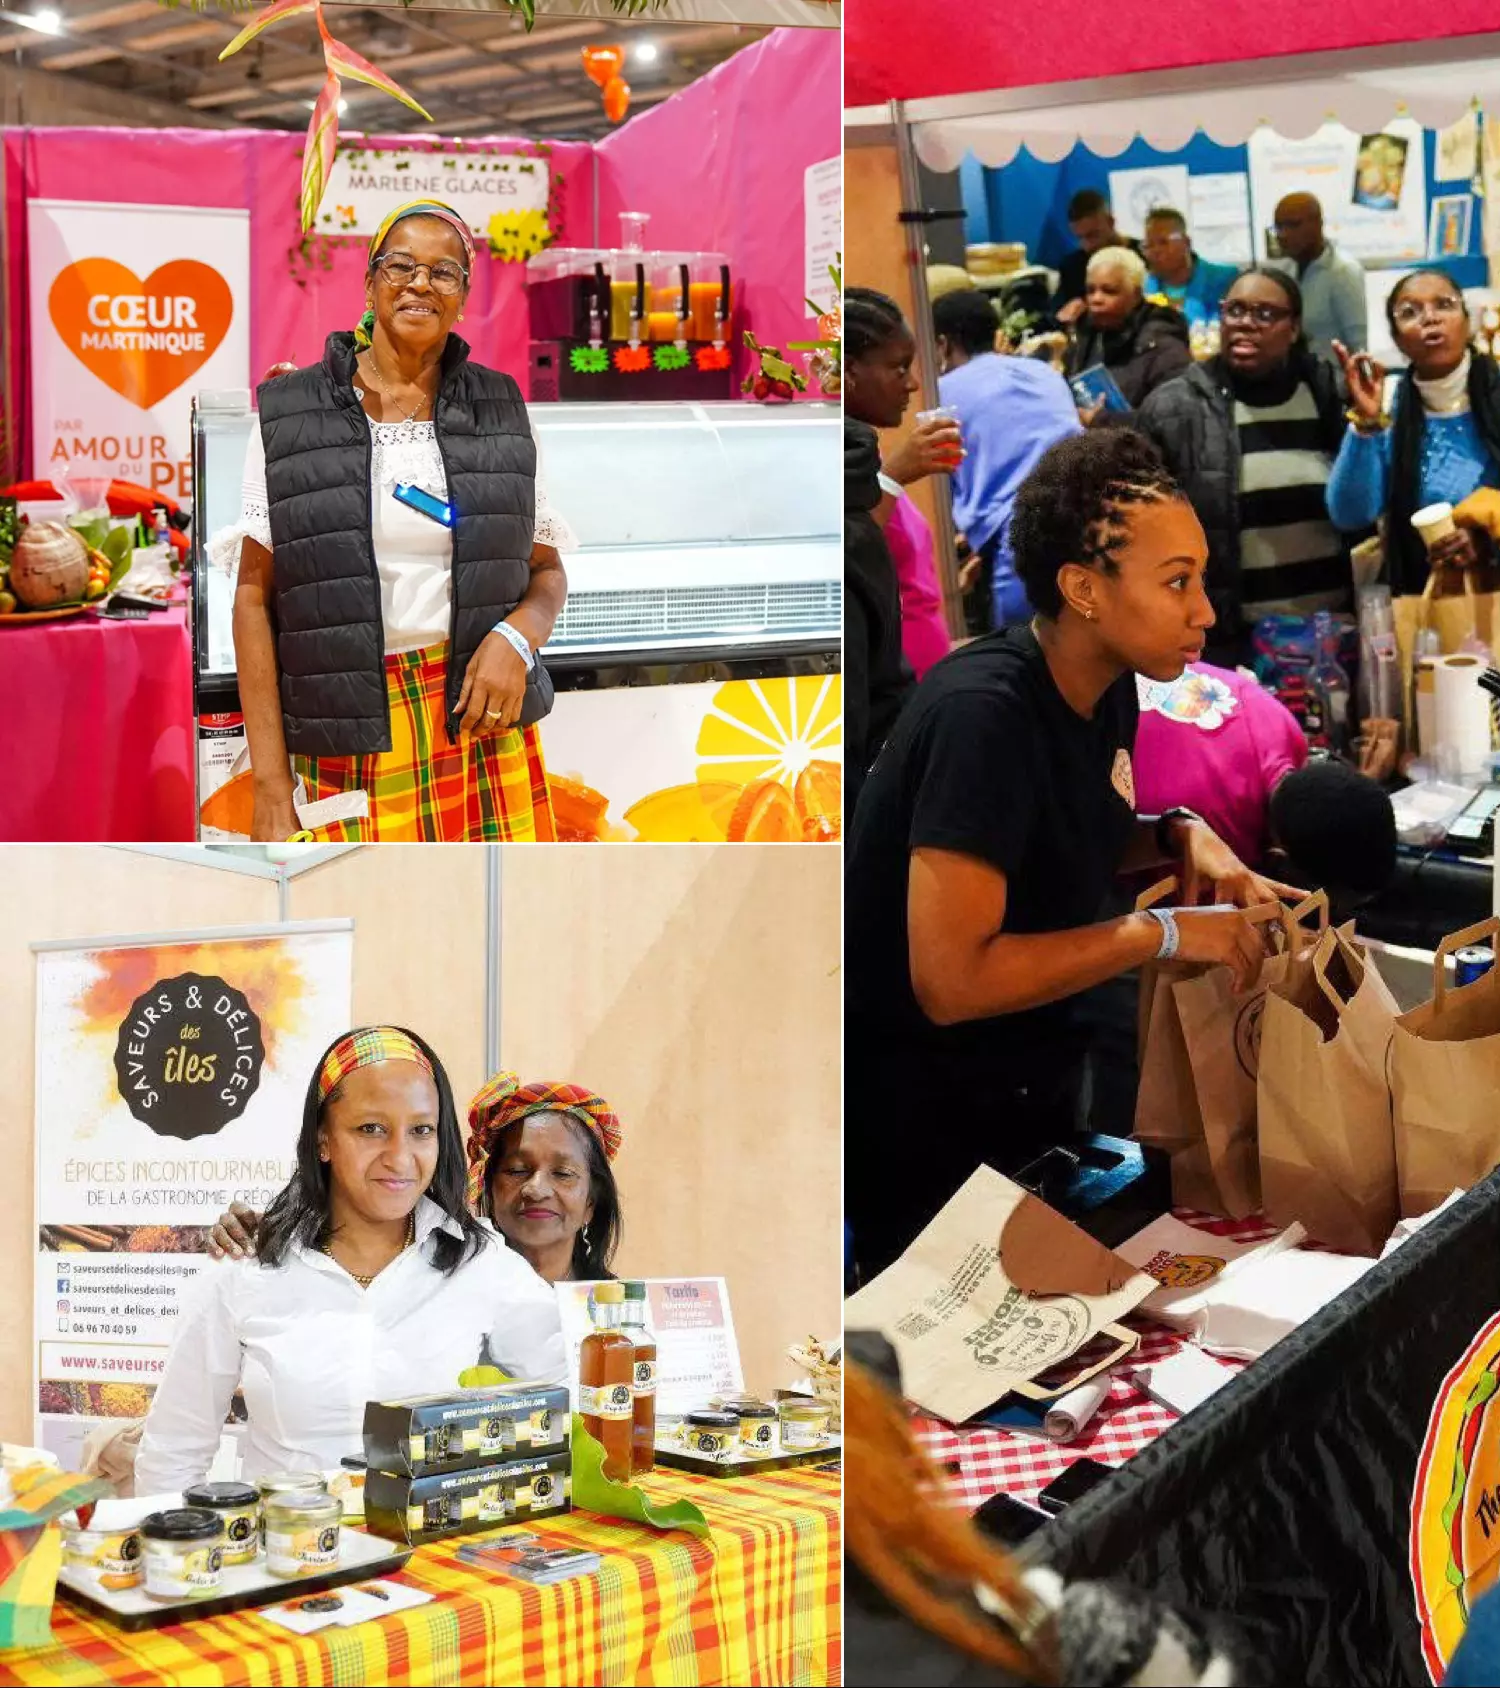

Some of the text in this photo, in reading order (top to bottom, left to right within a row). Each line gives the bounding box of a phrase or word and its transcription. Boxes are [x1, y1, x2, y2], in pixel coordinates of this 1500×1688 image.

[348, 175, 518, 195] MARLENE GLACES
[81, 331, 206, 355] MARTINIQUE
[54, 419, 83, 432] PAR
[50, 435, 167, 462] AMOUR
[119, 463, 143, 477] DU
[180, 1023, 201, 1040] des
[128, 985, 253, 1108] SAVEURS & DÉLICES
[164, 1045, 217, 1083] îles
[64, 1158, 126, 1183] ÉPICES
[87, 1189, 105, 1206] DE
[110, 1189, 127, 1206] LA
[131, 1189, 228, 1206] GASTRONOMIE
[73, 1263, 200, 1278] saveursetdelicesdesiles@gm
